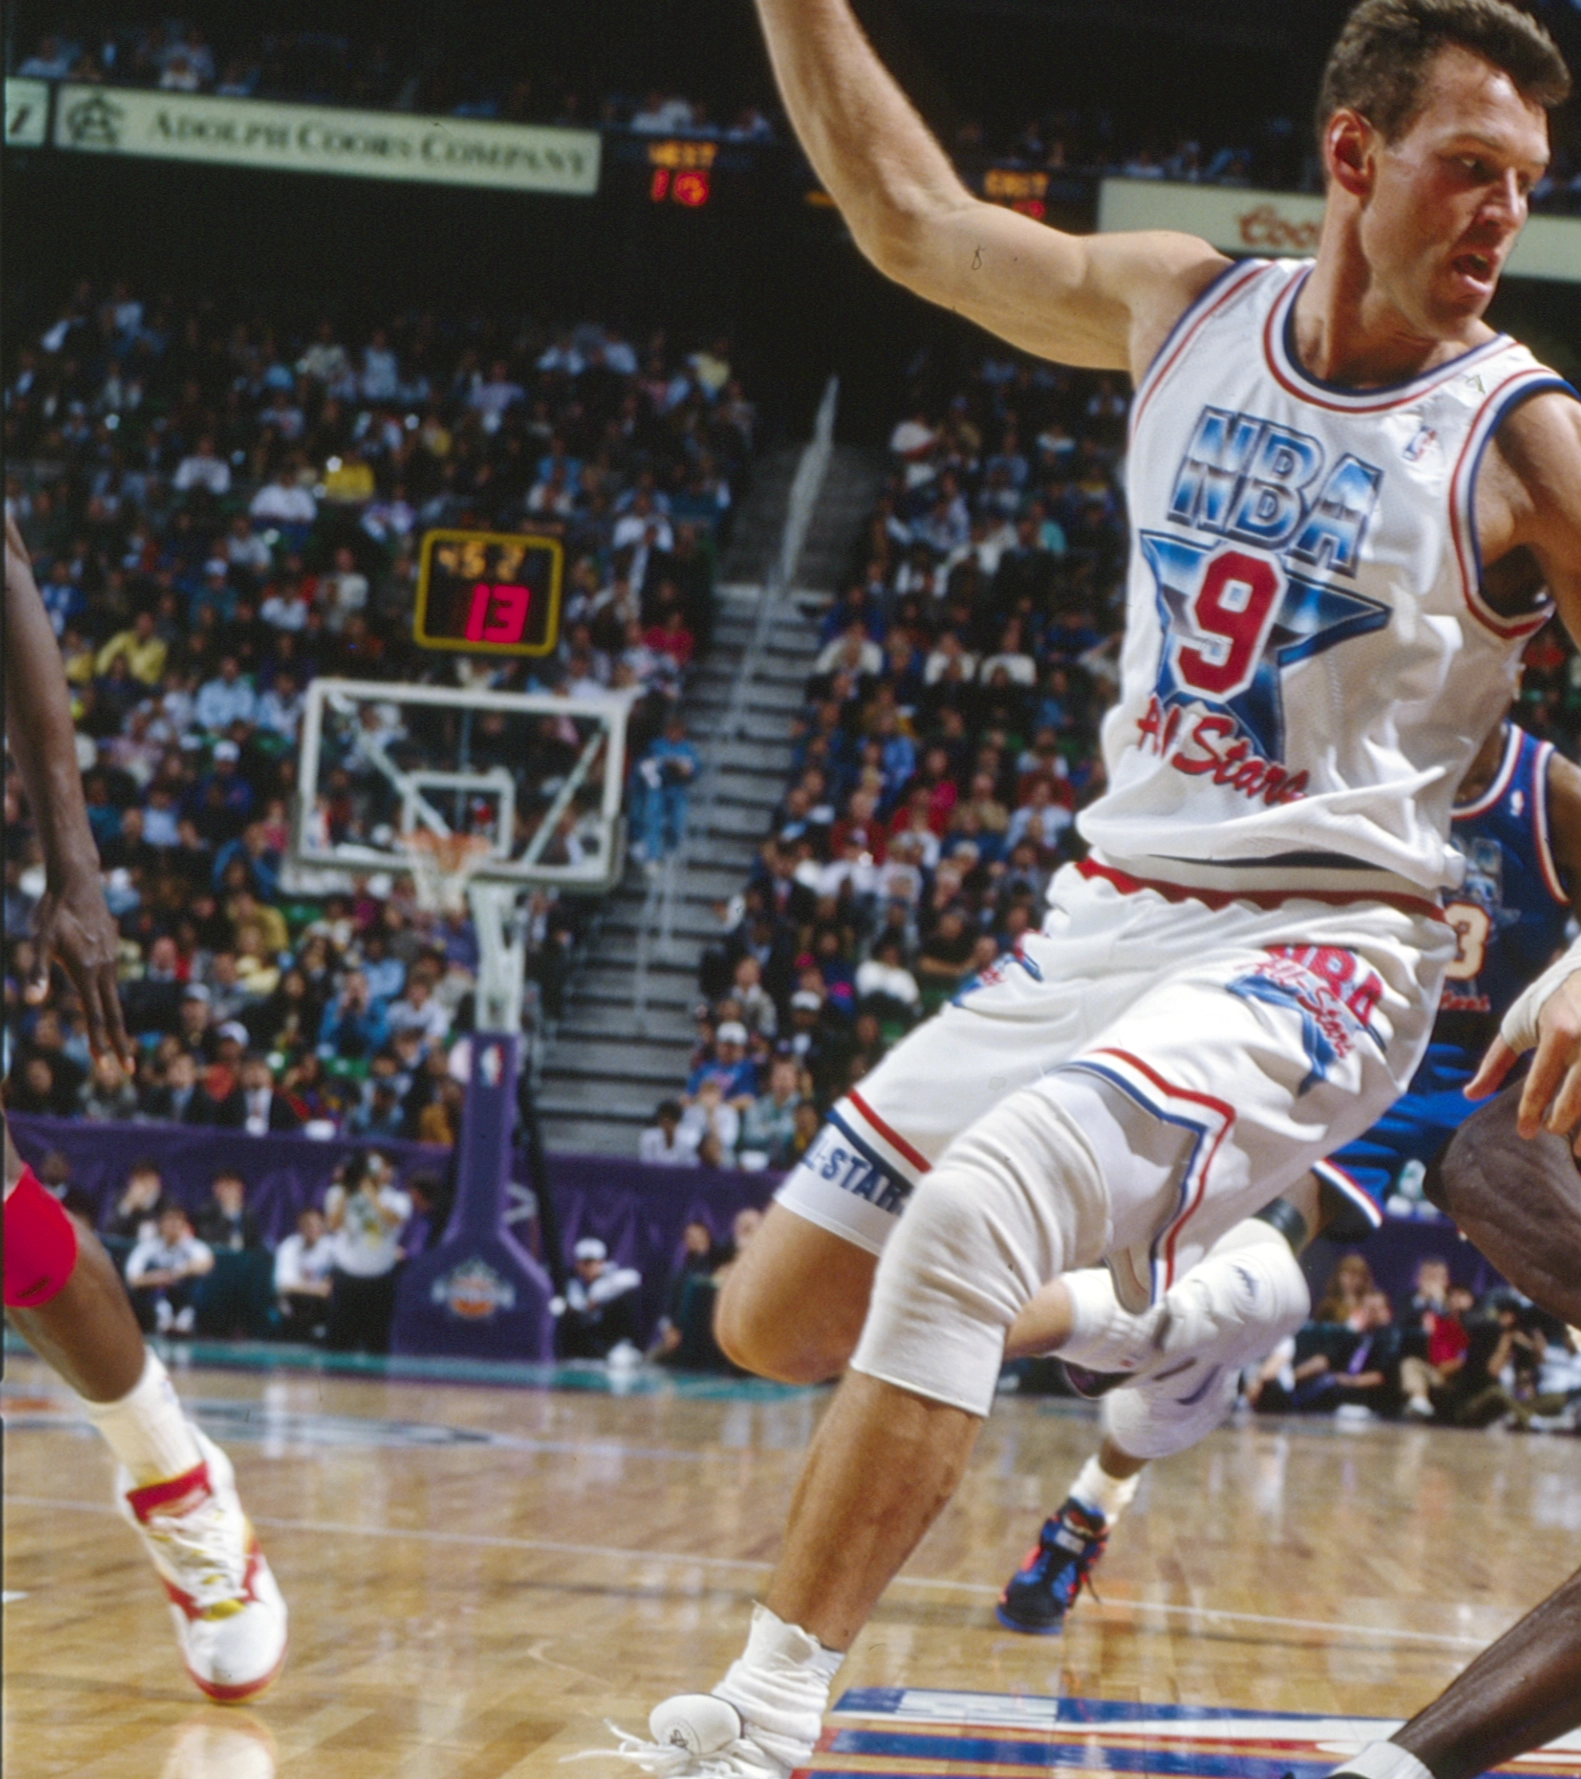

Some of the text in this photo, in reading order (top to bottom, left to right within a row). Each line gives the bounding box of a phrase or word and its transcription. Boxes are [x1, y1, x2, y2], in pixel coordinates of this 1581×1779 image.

[1238, 203, 1321, 249] Coo
[1166, 405, 1384, 579] NBA
[465, 582, 531, 644] 13
[1176, 546, 1288, 702] 9
